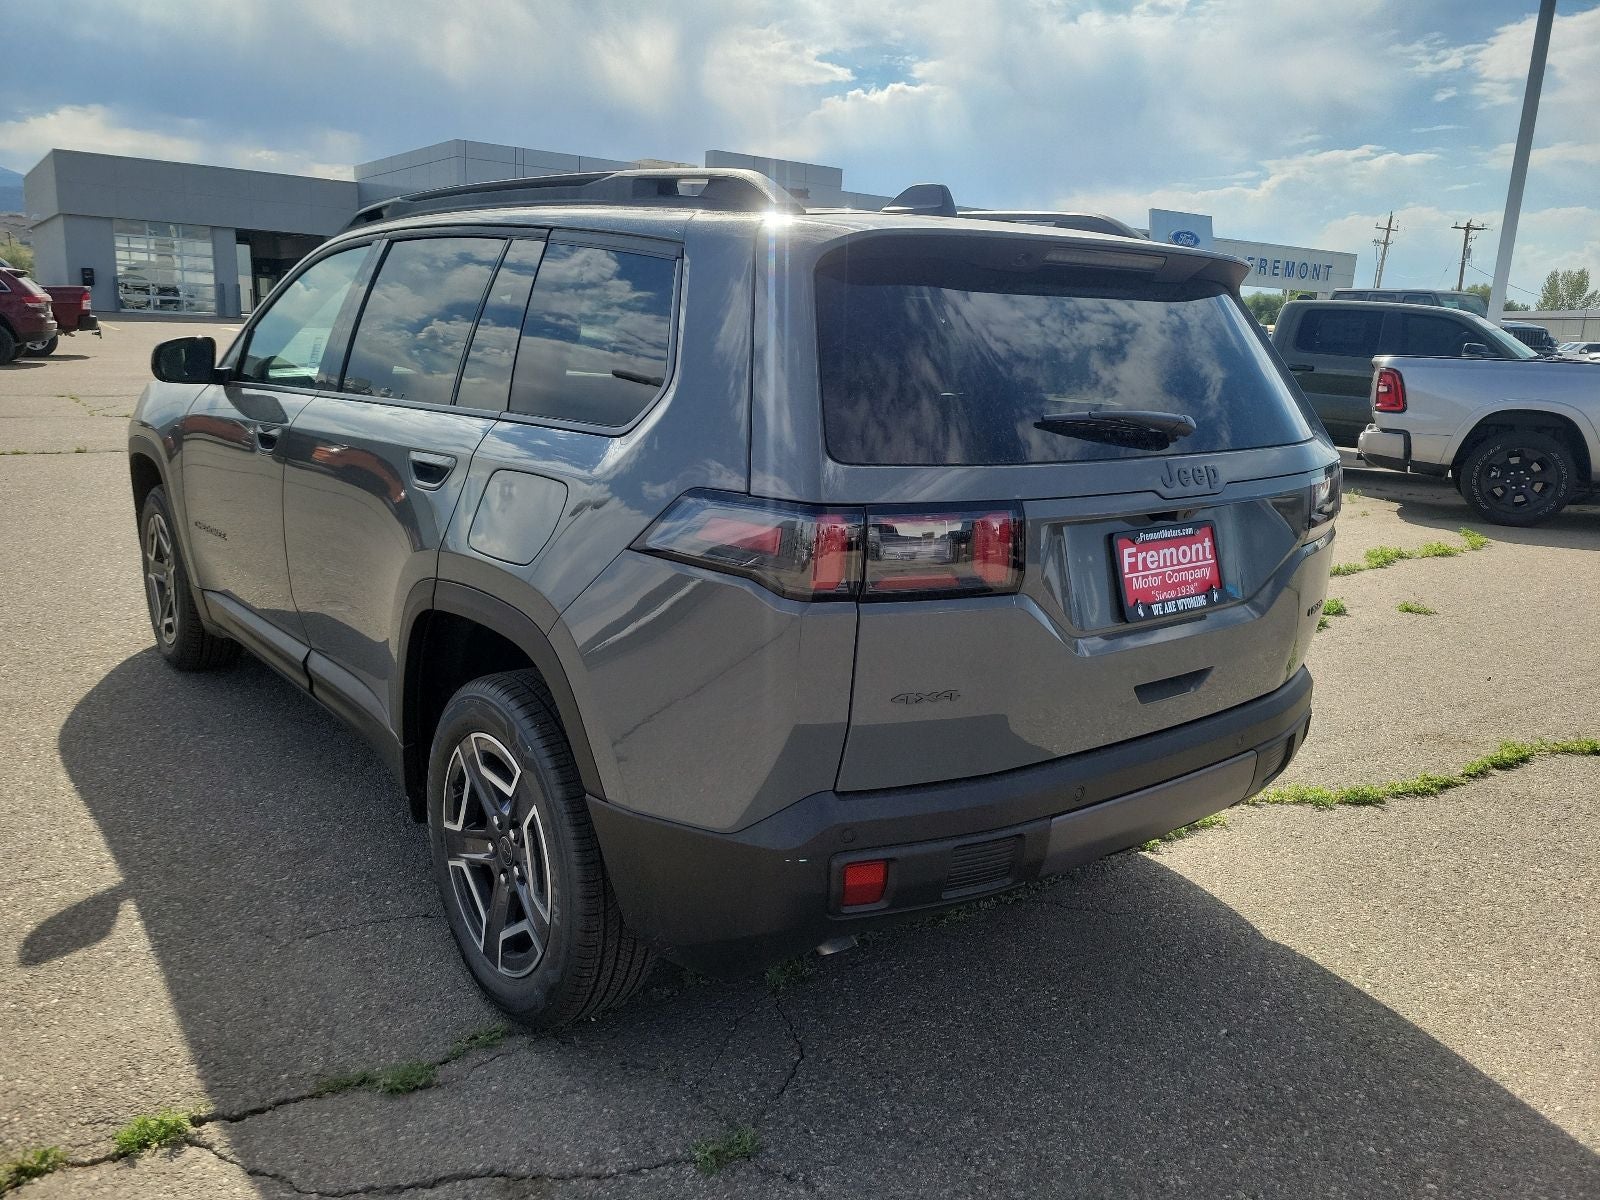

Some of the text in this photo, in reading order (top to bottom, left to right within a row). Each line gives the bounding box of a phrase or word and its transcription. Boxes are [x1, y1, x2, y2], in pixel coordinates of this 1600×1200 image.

[1160, 461, 1219, 489] Jeep
[1123, 537, 1212, 573] Fremont
[1132, 566, 1211, 590] Motor Company
[1151, 595, 1207, 616] WE ARE WYOMING
